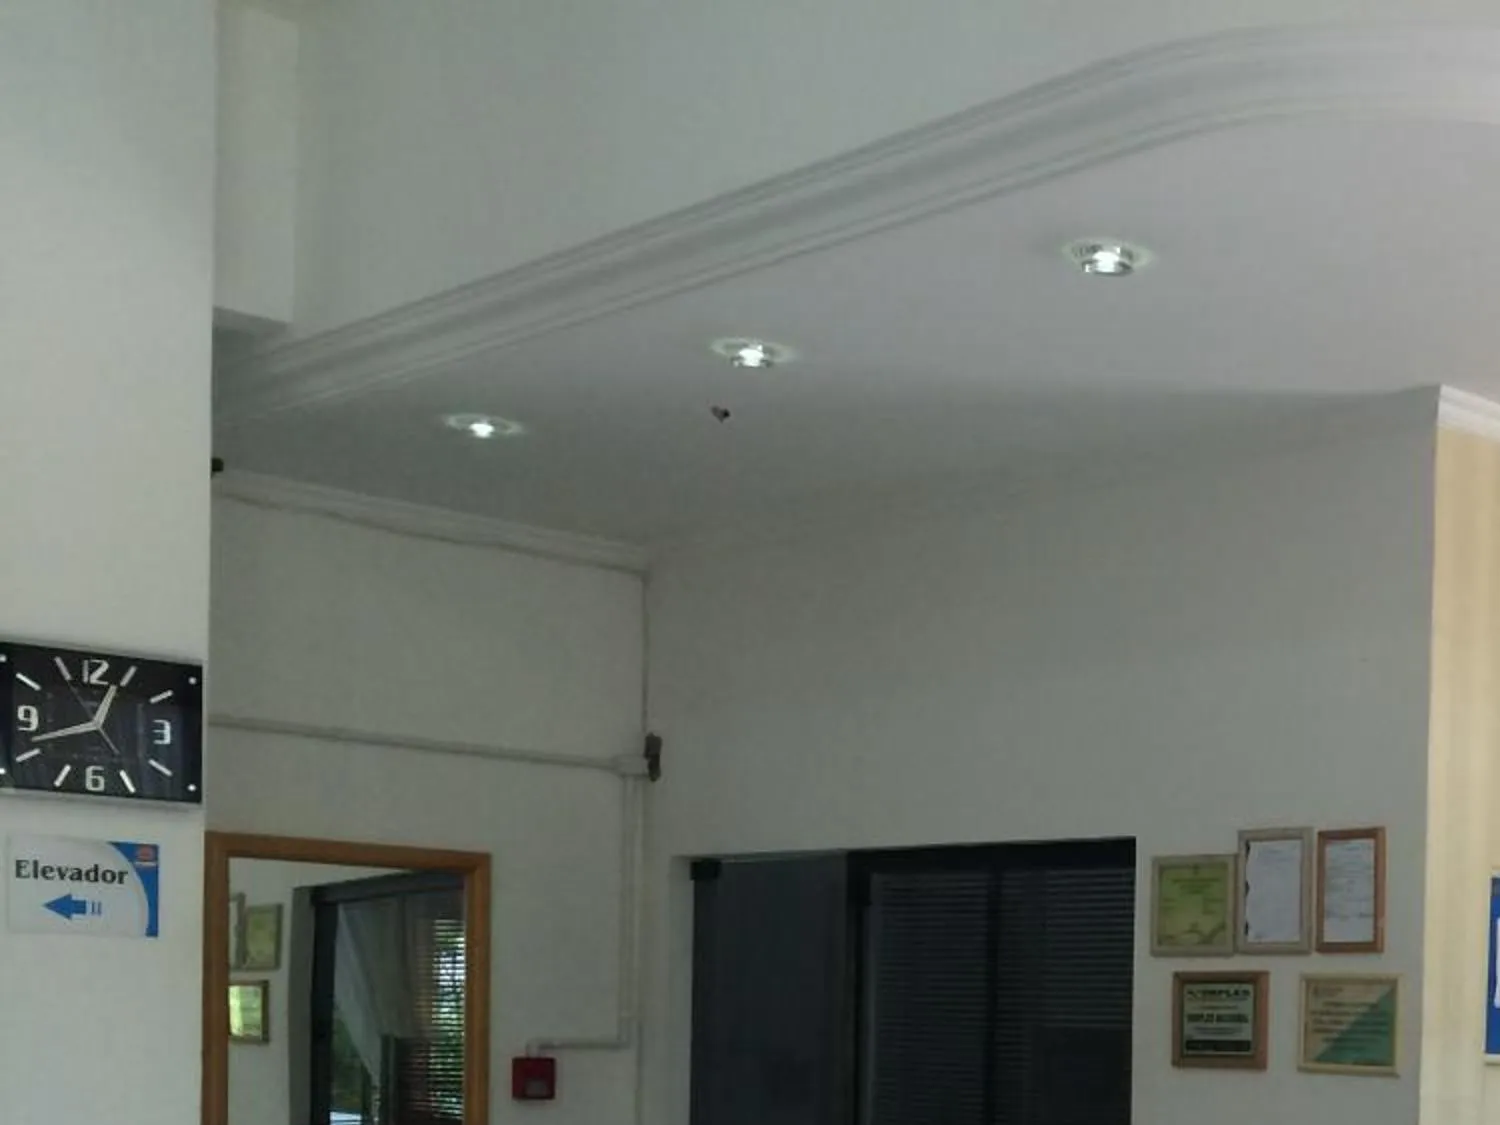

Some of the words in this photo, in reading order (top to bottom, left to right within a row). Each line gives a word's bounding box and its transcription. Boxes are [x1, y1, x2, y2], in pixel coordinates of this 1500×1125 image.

[82, 659, 109, 685] 12
[17, 705, 39, 731] 9
[152, 719, 171, 745] 3
[85, 765, 105, 791] 6
[15, 859, 129, 885] Elevador
